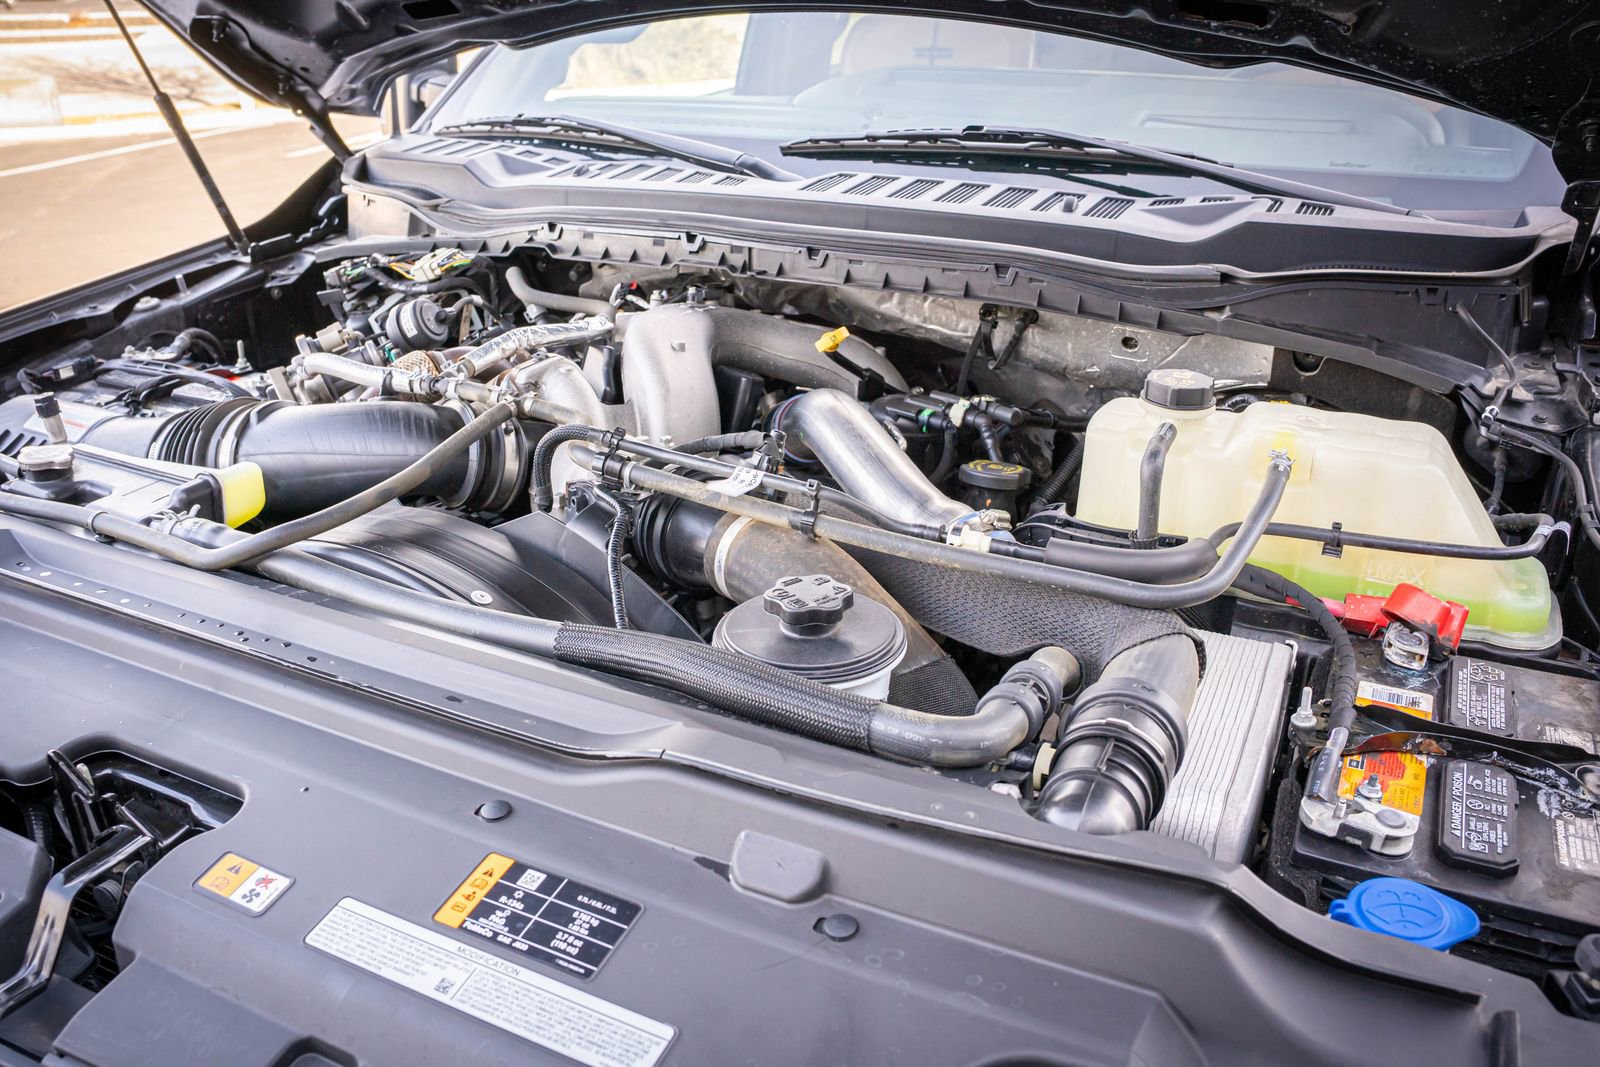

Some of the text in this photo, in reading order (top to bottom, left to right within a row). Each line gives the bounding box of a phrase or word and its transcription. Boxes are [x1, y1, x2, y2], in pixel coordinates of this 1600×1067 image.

[1376, 563, 1426, 586] MAX
[1453, 771, 1463, 795] POISON
[1451, 801, 1462, 830] DANGER
[498, 895, 525, 911] R-134a
[488, 914, 507, 926] PAG
[462, 921, 494, 938] FoMoCo
[496, 935, 513, 945] SAE
[457, 946, 521, 976] MODIFICATION
